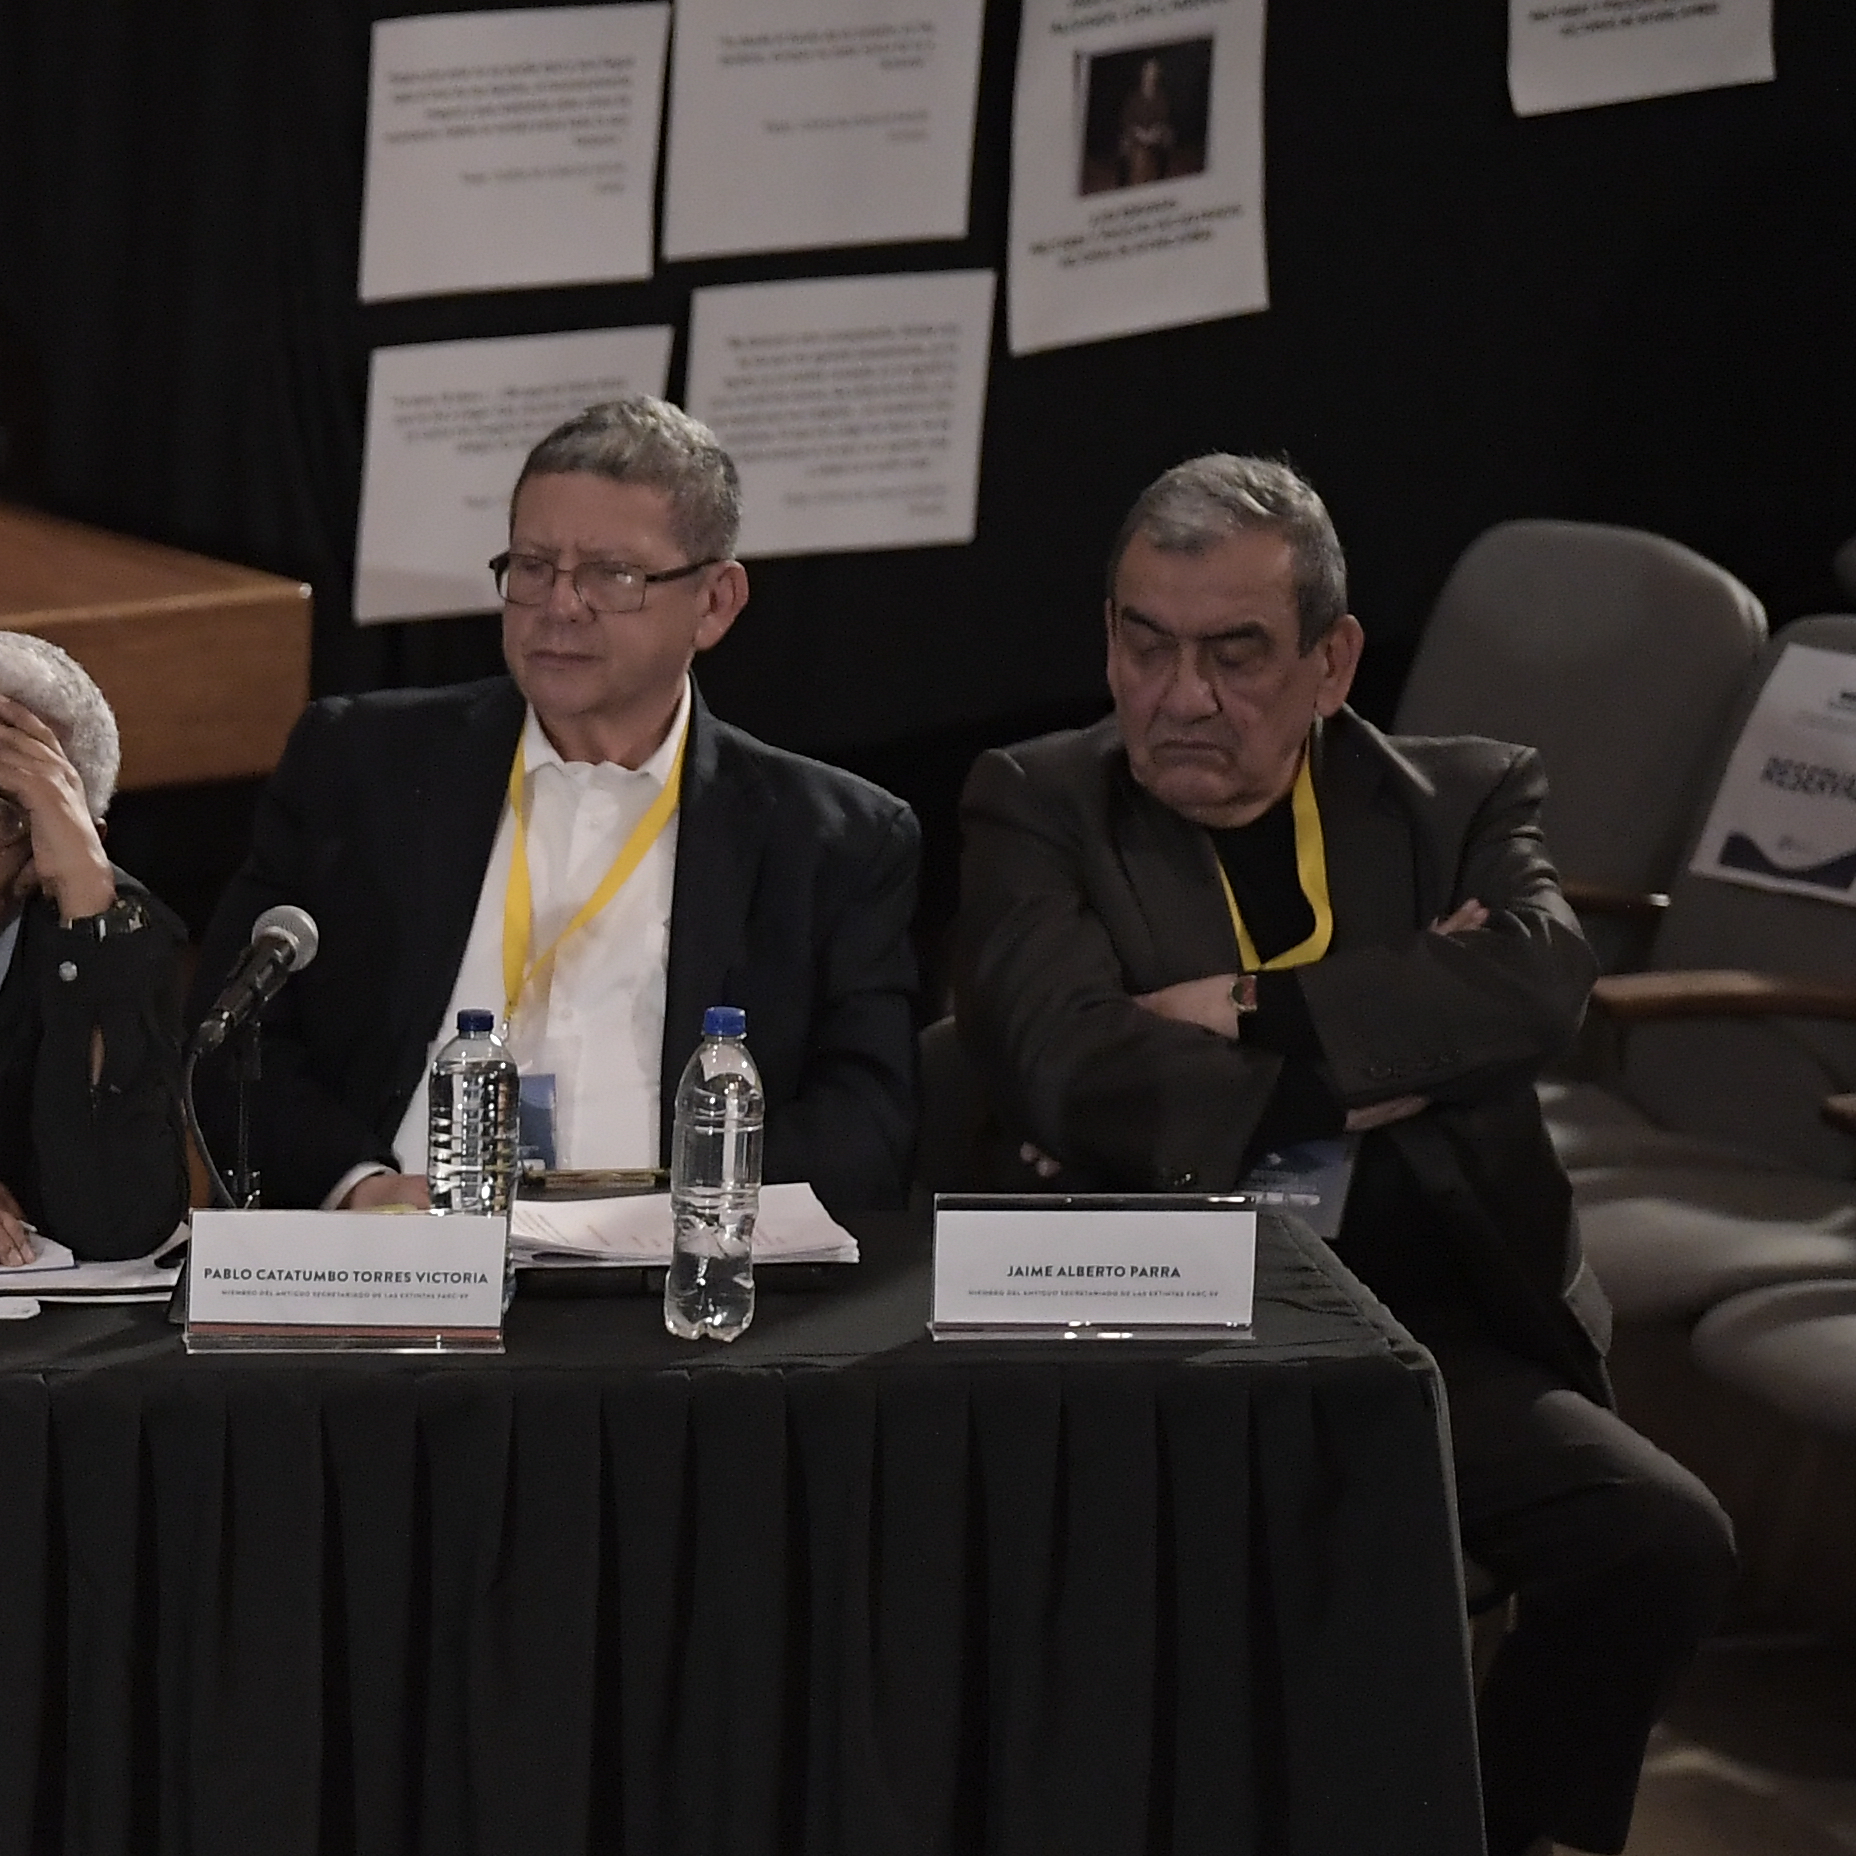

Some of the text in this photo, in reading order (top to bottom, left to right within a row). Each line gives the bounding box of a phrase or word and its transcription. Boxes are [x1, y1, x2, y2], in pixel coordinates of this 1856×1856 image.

[204, 1267, 489, 1284] PABLO CATATUMBO TORRES VICTORIA
[1006, 1265, 1181, 1278] JAIME ALBERTO PARRA
